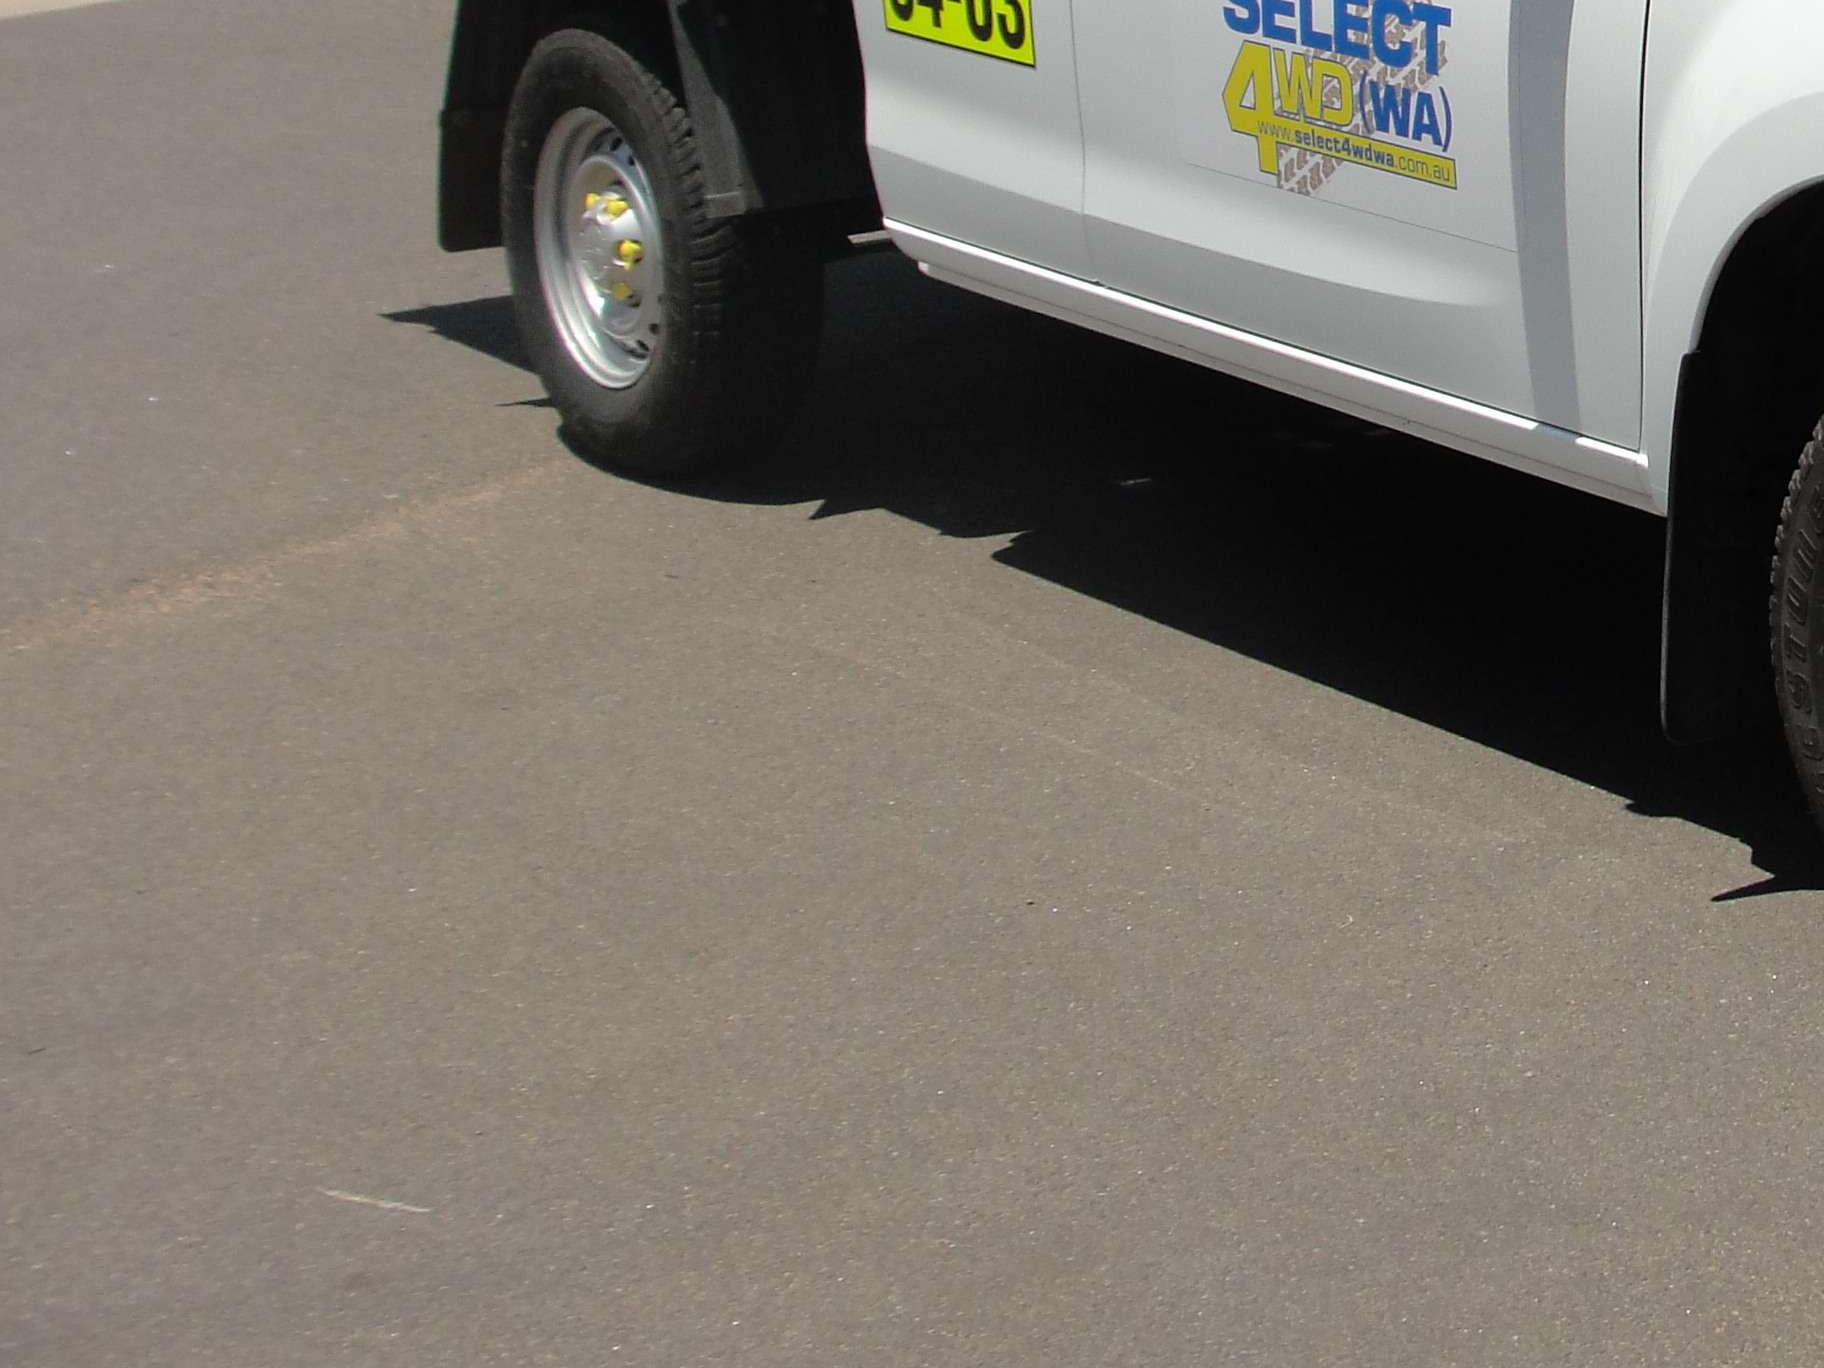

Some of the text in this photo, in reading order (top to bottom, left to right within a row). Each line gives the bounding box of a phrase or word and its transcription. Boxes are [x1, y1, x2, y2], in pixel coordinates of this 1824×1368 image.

[1221, 39, 1453, 176] 4WD (WA)
[1257, 120, 1451, 182] www.select4wdwa.com.au
